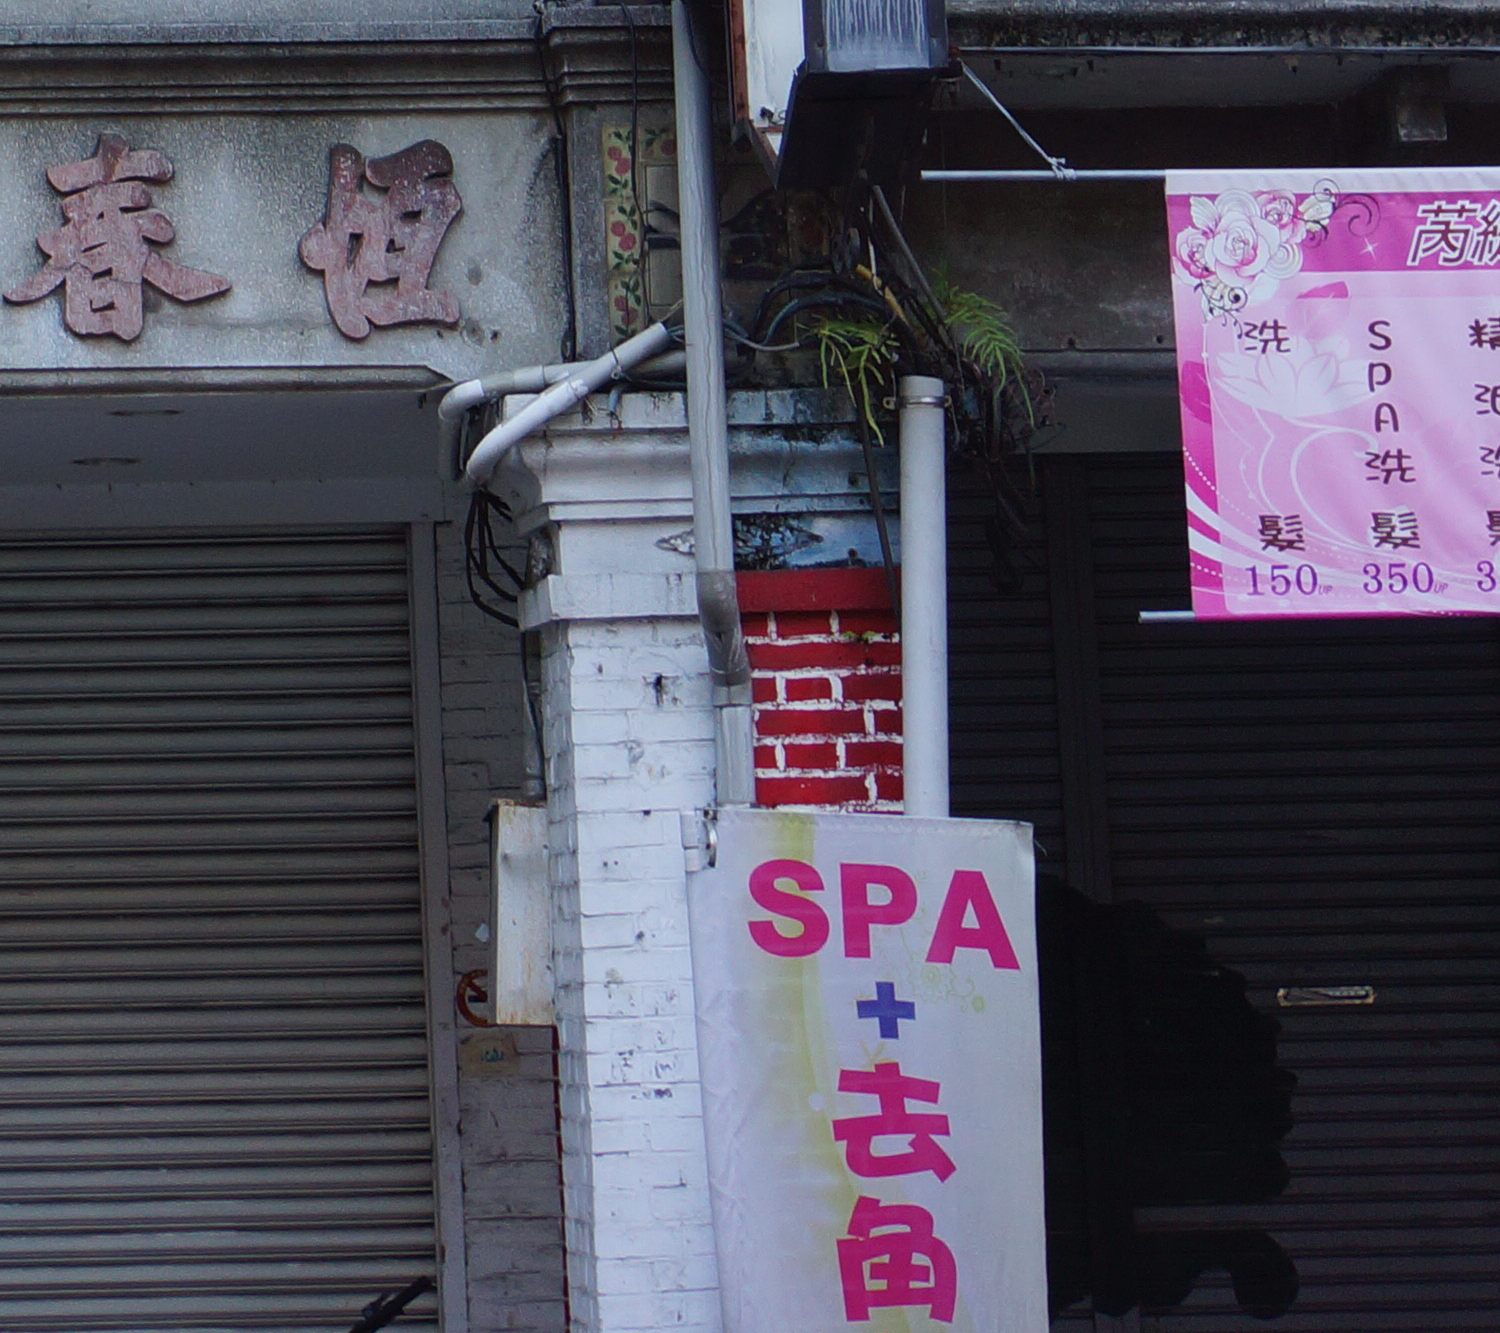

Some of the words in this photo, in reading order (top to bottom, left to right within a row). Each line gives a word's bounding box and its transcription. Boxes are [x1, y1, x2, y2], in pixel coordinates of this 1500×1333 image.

[1245, 564, 1318, 596] 150
[1362, 562, 1434, 594] 350
[747, 859, 1021, 972] SPA
